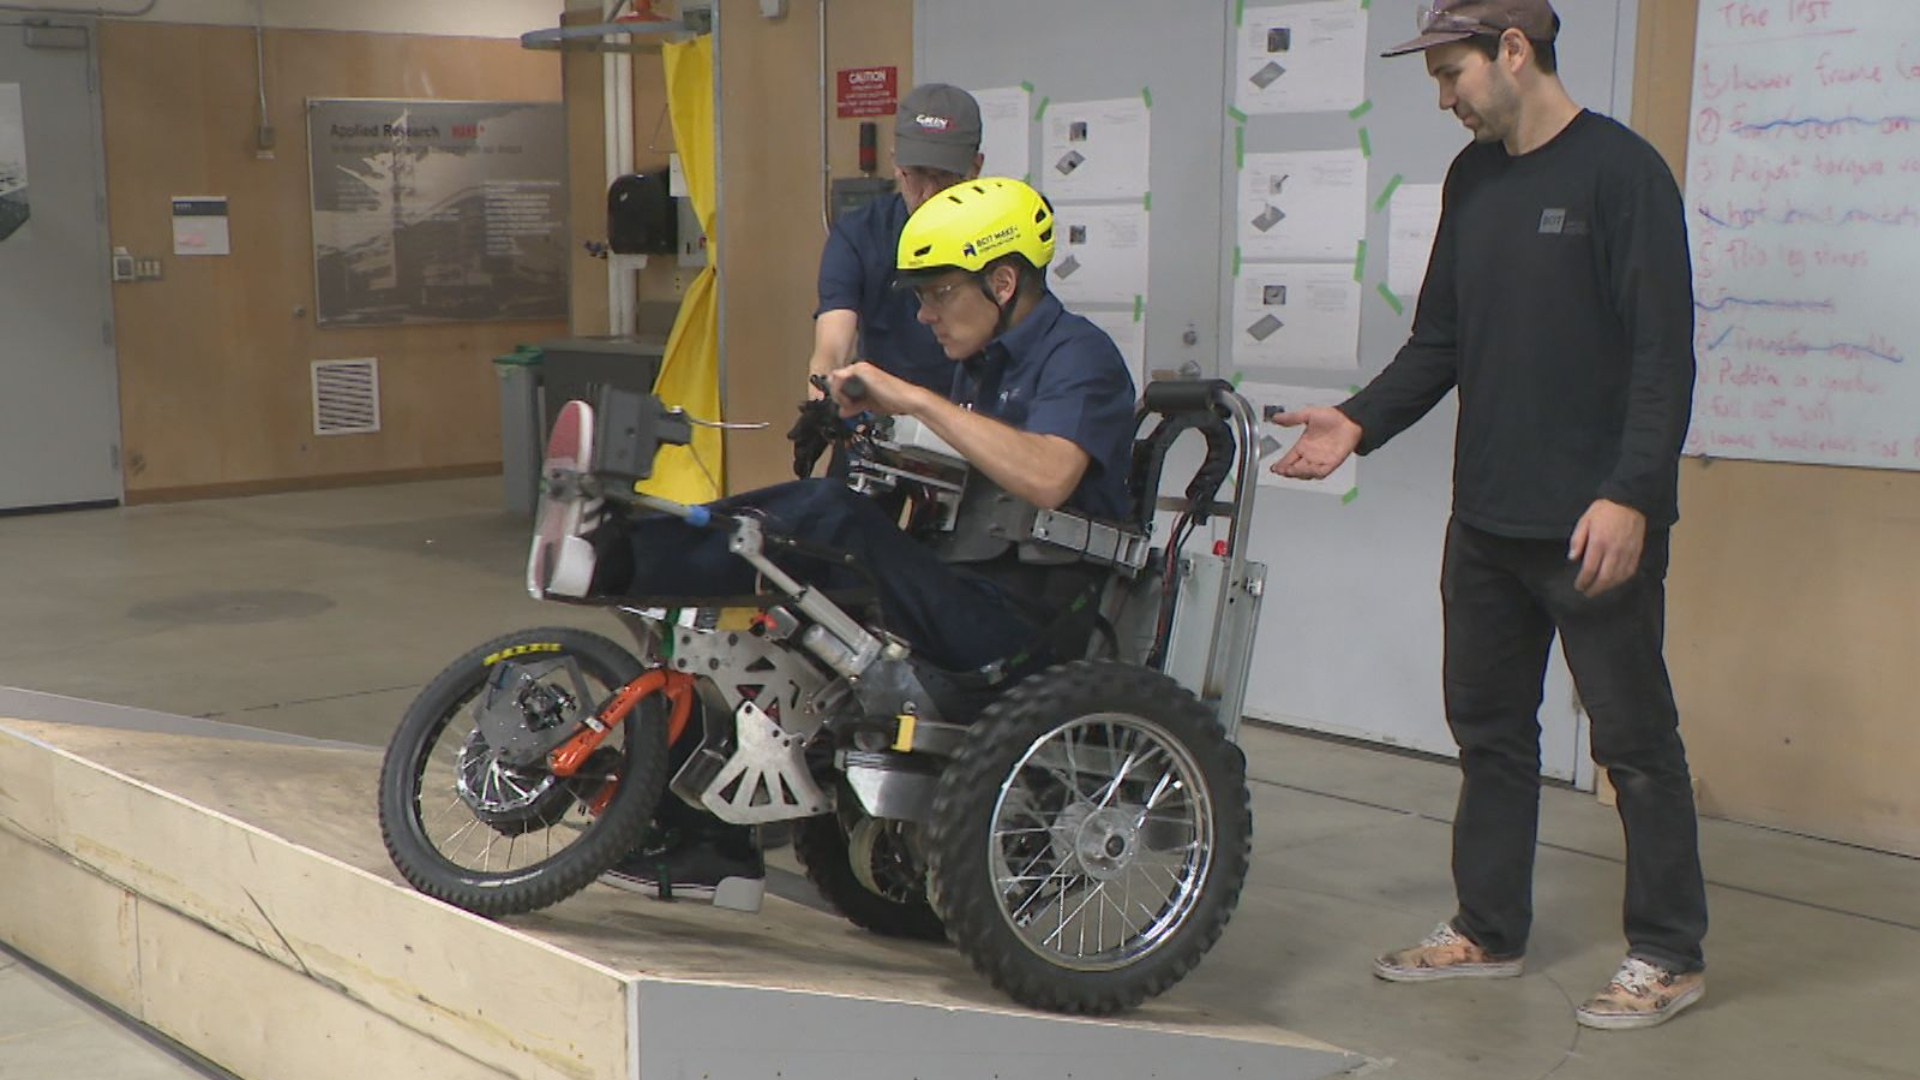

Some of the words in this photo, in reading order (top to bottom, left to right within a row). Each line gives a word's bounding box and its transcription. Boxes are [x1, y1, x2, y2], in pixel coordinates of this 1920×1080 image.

[848, 70, 887, 84] CAUTION
[330, 124, 378, 139] Applied
[383, 123, 440, 138] Research
